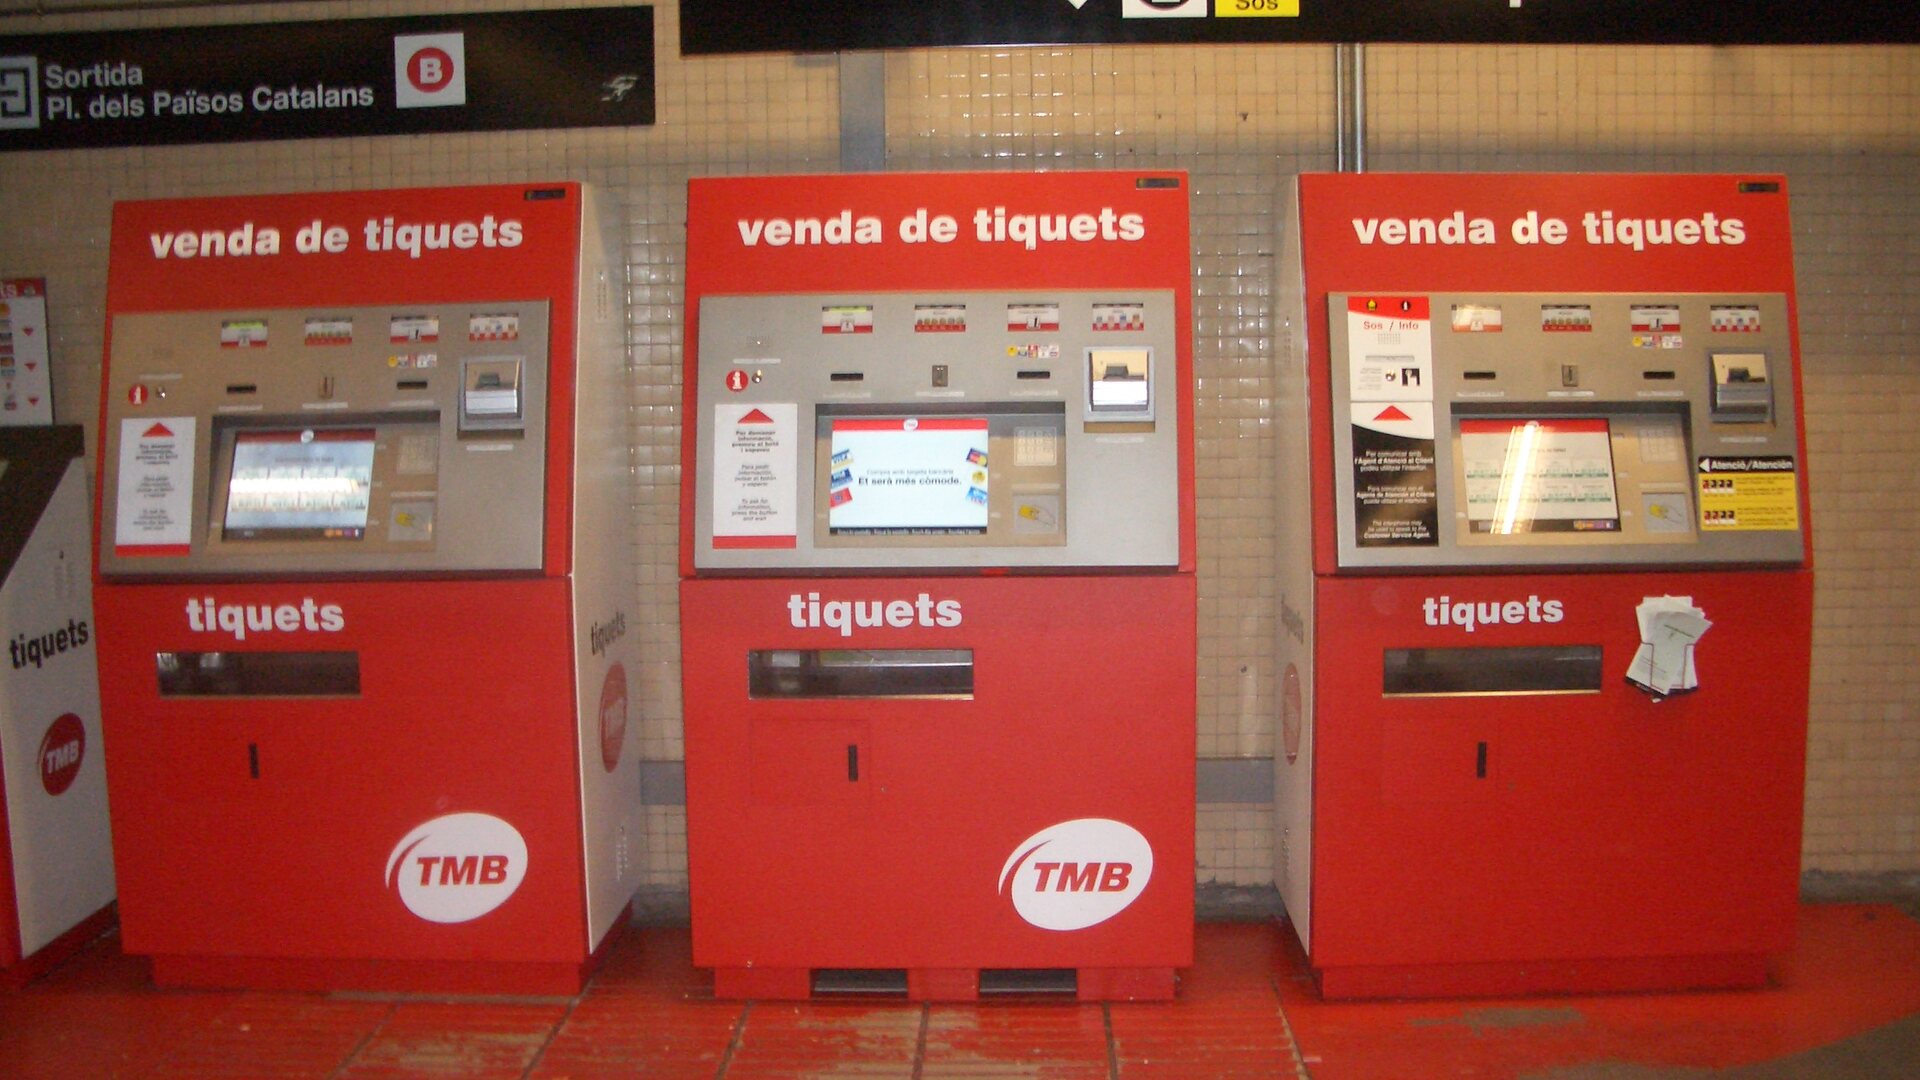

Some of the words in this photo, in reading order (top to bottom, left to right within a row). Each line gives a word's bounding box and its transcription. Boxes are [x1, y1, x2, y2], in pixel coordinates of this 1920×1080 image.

[1236, 0, 1278, 11] Sos
[46, 62, 143, 89] Sortida
[418, 57, 442, 85] B
[48, 96, 80, 119] Pl.
[89, 94, 145, 118] dels
[153, 89, 243, 116] Països
[252, 84, 374, 111] Catalans
[150, 221, 280, 259] venda
[295, 219, 349, 254] de
[364, 215, 523, 258] tiquets
[738, 210, 882, 246] venda
[899, 208, 958, 244] de
[974, 206, 1145, 250] tiquets
[1352, 211, 1495, 245] venda
[1511, 211, 1568, 244] de
[1583, 211, 1745, 251] tiquets
[1363, 321, 1383, 330] Sos
[1399, 321, 1419, 330] Info
[858, 477, 868, 485] Et
[871, 477, 892, 485] serà
[895, 477, 916, 485] més
[919, 476, 962, 485] còmode.
[186, 597, 345, 640] tiquets
[788, 592, 962, 637] tiquets
[1423, 595, 1564, 632] tiquets
[9, 618, 89, 669] tiquets
[591, 612, 626, 657] tiquets
[45, 739, 80, 774] TMB
[416, 855, 509, 887] TMB
[1033, 862, 1133, 892] TMB
